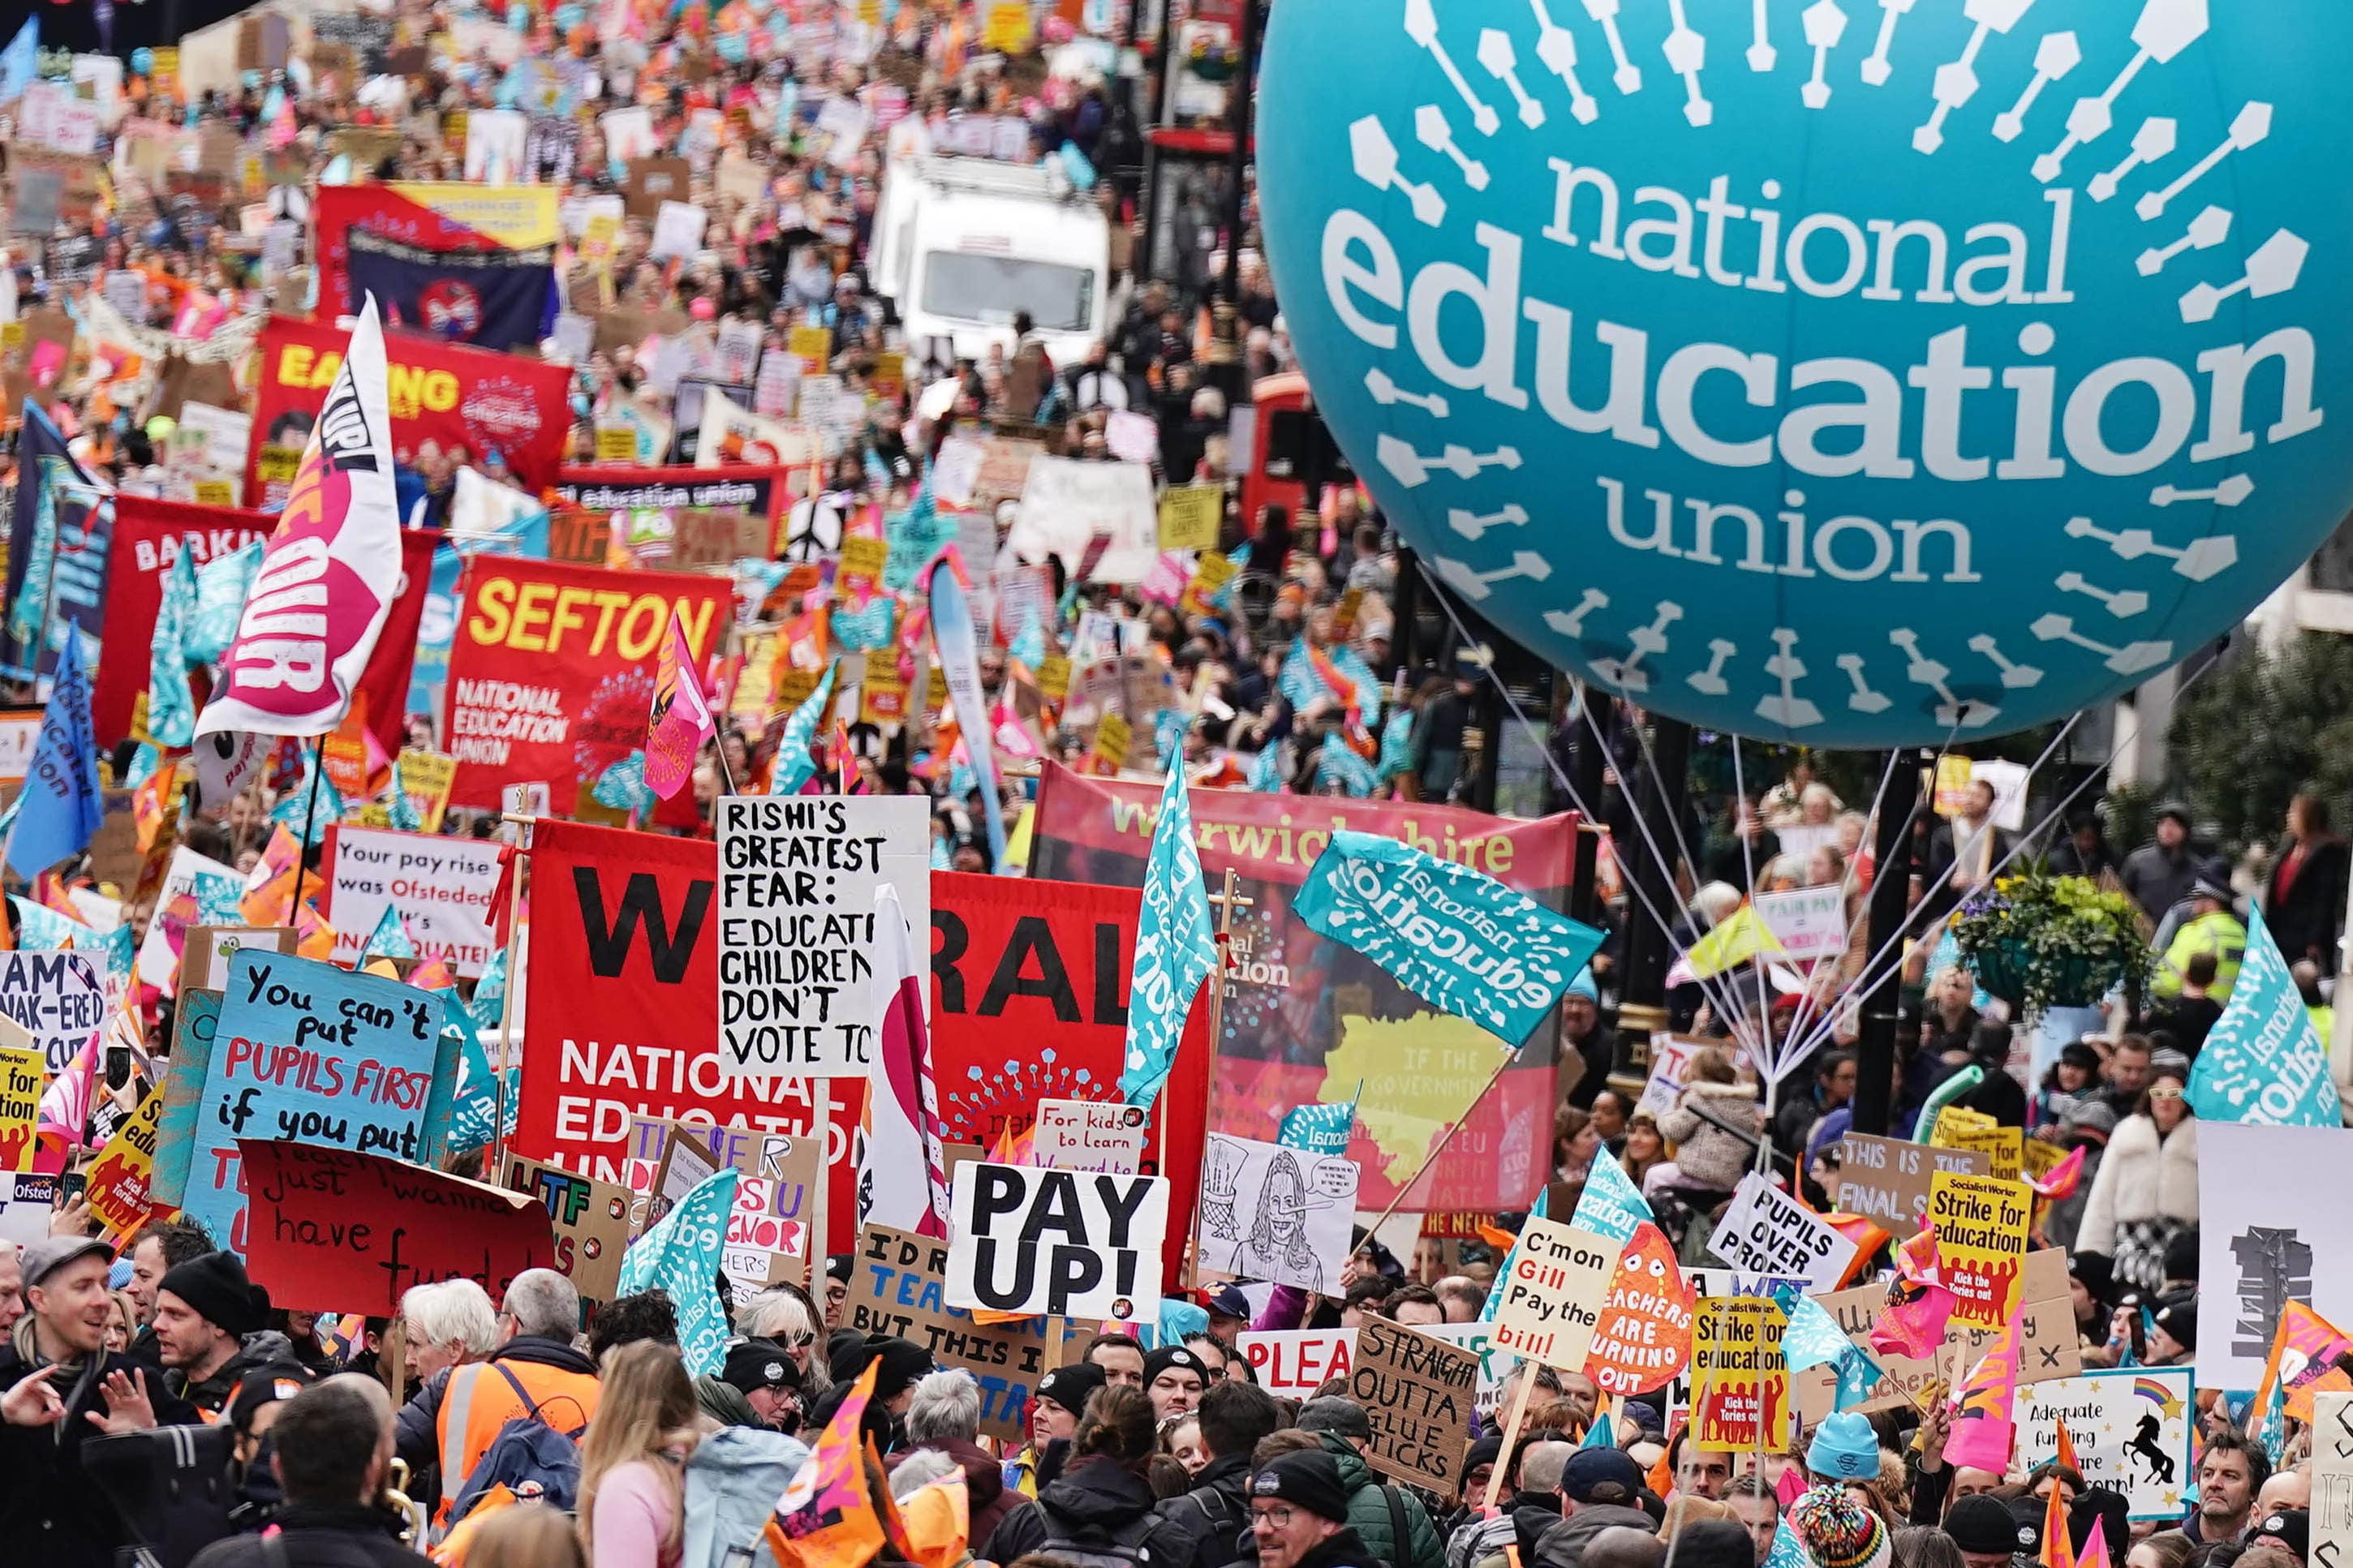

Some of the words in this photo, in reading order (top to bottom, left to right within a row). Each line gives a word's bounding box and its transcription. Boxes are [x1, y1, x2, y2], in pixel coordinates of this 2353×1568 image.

[1542, 154, 2076, 308] national
[1321, 206, 2325, 484] education
[1596, 473, 1983, 586] union
[468, 577, 716, 664] SEFTON
[455, 677, 562, 715] NATIONAL
[454, 707, 570, 743] EDUCATION
[450, 737, 511, 767] UNION
[727, 800, 846, 834] RISHI'S
[339, 842, 392, 864] Your
[399, 853, 443, 874] pay
[449, 853, 491, 875] rise
[725, 835, 887, 874] GREATEST
[338, 878, 383, 896] was
[391, 879, 494, 907] Ofsteded
[725, 870, 837, 908] FEAR:
[2, 953, 65, 994] AM
[247, 964, 313, 1006] You
[338, 998, 430, 1041] can't
[722, 986, 839, 1025] DON'T
[295, 1016, 357, 1047] put
[725, 1025, 822, 1065] VOTE
[9, 1067, 39, 1093] for
[225, 1037, 343, 1097] PUPILS
[351, 1059, 432, 1110] FIRST
[218, 1088, 262, 1134] if
[278, 1109, 348, 1142] you
[356, 1120, 419, 1159] put
[1042, 1107, 1078, 1128] For
[1086, 1110, 1125, 1131] kids
[1059, 1132, 1077, 1148] to
[1084, 1131, 1130, 1149] learn
[1843, 1139, 1886, 1169] THIS
[1899, 1148, 1920, 1175] IS
[15, 1184, 52, 1200] Ofsted
[112, 1183, 138, 1209] Tories
[123, 1176, 144, 1196] Kick
[263, 1166, 349, 1202] just
[393, 1183, 512, 1216] wanna
[1837, 1182, 1906, 1222] FINAL
[1950, 1179, 1989, 1193] Socialist
[1988, 1184, 2018, 1198] Worker
[971, 1164, 1154, 1248] PAY
[1753, 1188, 1833, 1257] PUPILS
[1934, 1190, 1993, 1222] Strike
[1999, 1200, 2025, 1226] for
[273, 1205, 372, 1252] have
[1934, 1219, 2022, 1254] education
[865, 1232, 918, 1266] I'D
[1526, 1231, 1604, 1270] C'mon
[1750, 1222, 1810, 1275] OVER
[973, 1237, 1138, 1316] UP!
[1517, 1259, 1566, 1291] Gill
[1948, 1282, 1975, 1298] Tories
[1977, 1287, 1992, 1300] out
[1954, 1270, 1972, 1285] Kick
[1975, 1272, 1990, 1288] the
[1508, 1284, 1555, 1321] Pay
[1559, 1301, 1597, 1327] the
[1602, 1287, 1693, 1330] EACHERS
[1710, 1301, 1748, 1312] Soalist
[853, 1304, 913, 1338] BUT
[925, 1324, 1009, 1365] THIS
[1496, 1323, 1555, 1359] bill!
[1610, 1315, 1657, 1346] ARE
[1361, 1323, 1478, 1390] STRAIGHT
[1589, 1333, 1677, 1368] URNING
[1353, 1366, 1457, 1425] OUTTA
[1598, 1366, 1643, 1393] OUT
[1720, 1409, 1746, 1422] Tories
[1724, 1396, 1743, 1410] Kick
[1745, 1396, 1758, 1410] the
[2029, 1402, 2103, 1424] Adequate
[1365, 1406, 1443, 1450] GLUE
[1370, 1430, 1448, 1478] TICKS
